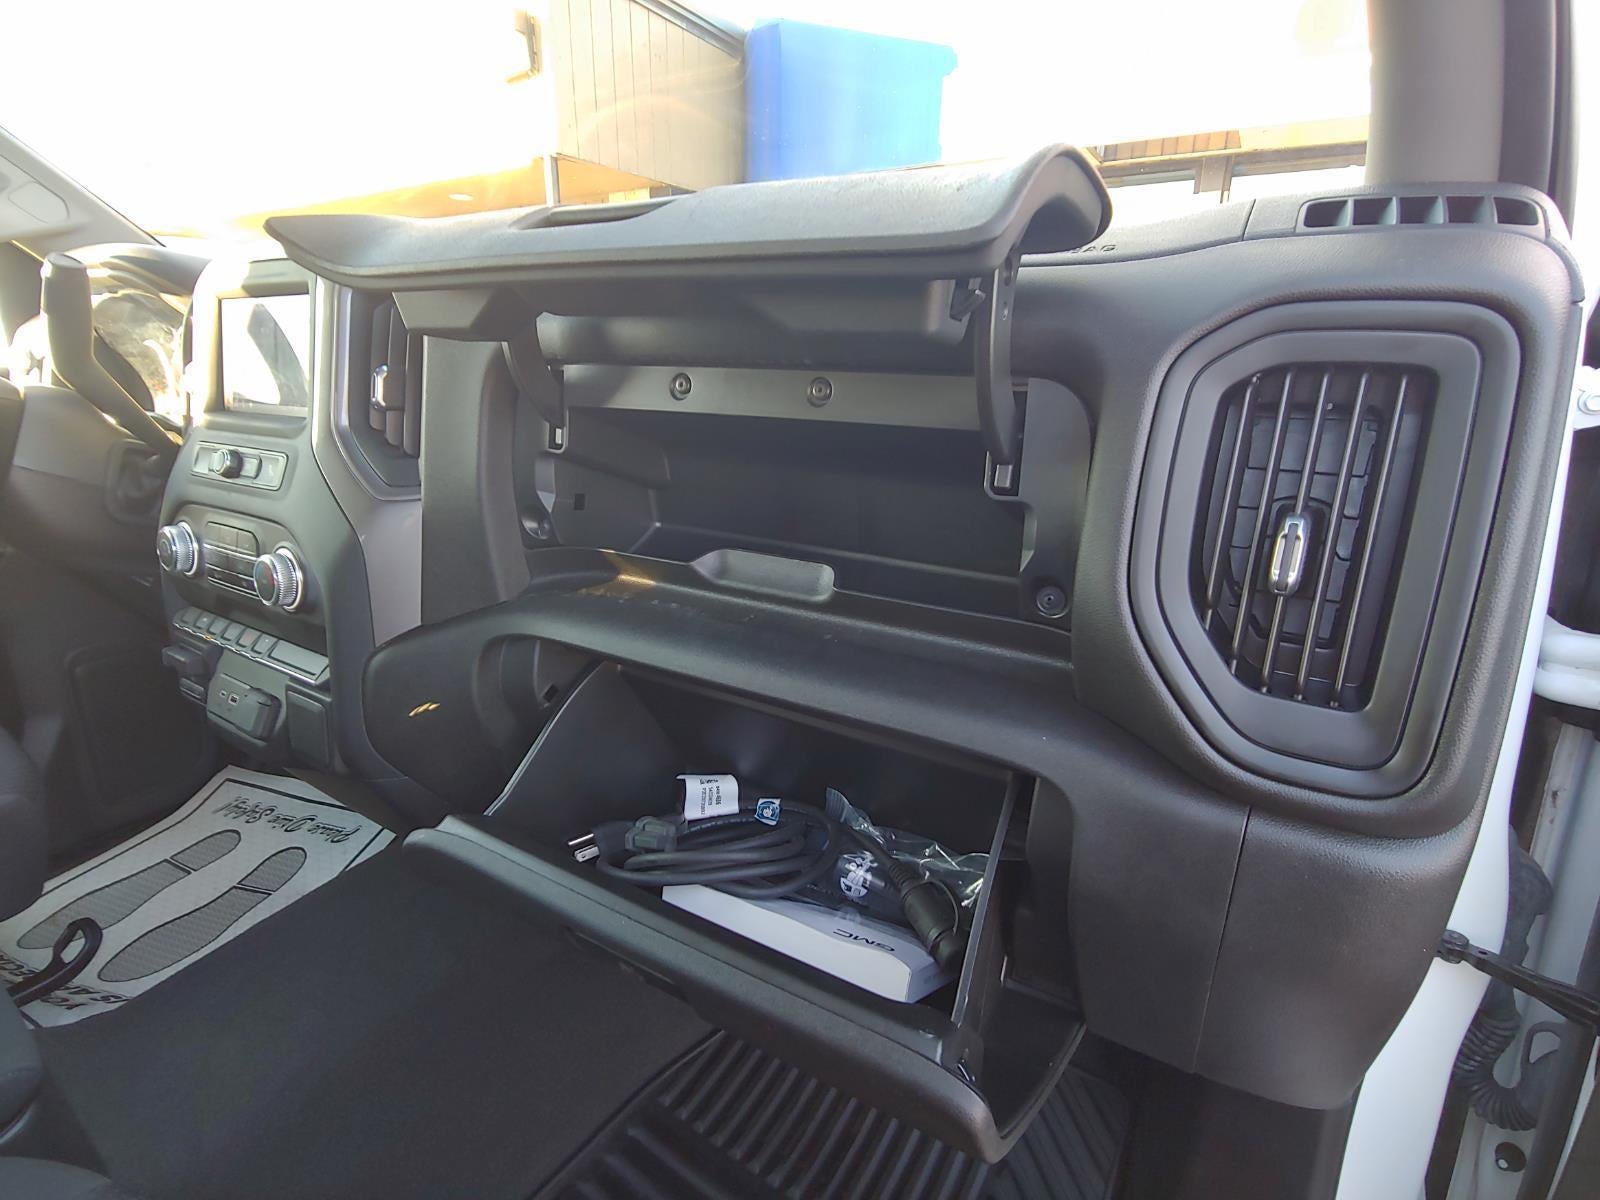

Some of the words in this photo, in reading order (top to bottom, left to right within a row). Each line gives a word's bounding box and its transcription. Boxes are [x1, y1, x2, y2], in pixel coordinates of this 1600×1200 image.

[267, 813, 318, 833] Drive
[308, 822, 363, 843] Please
[833, 928, 895, 952] GMC
